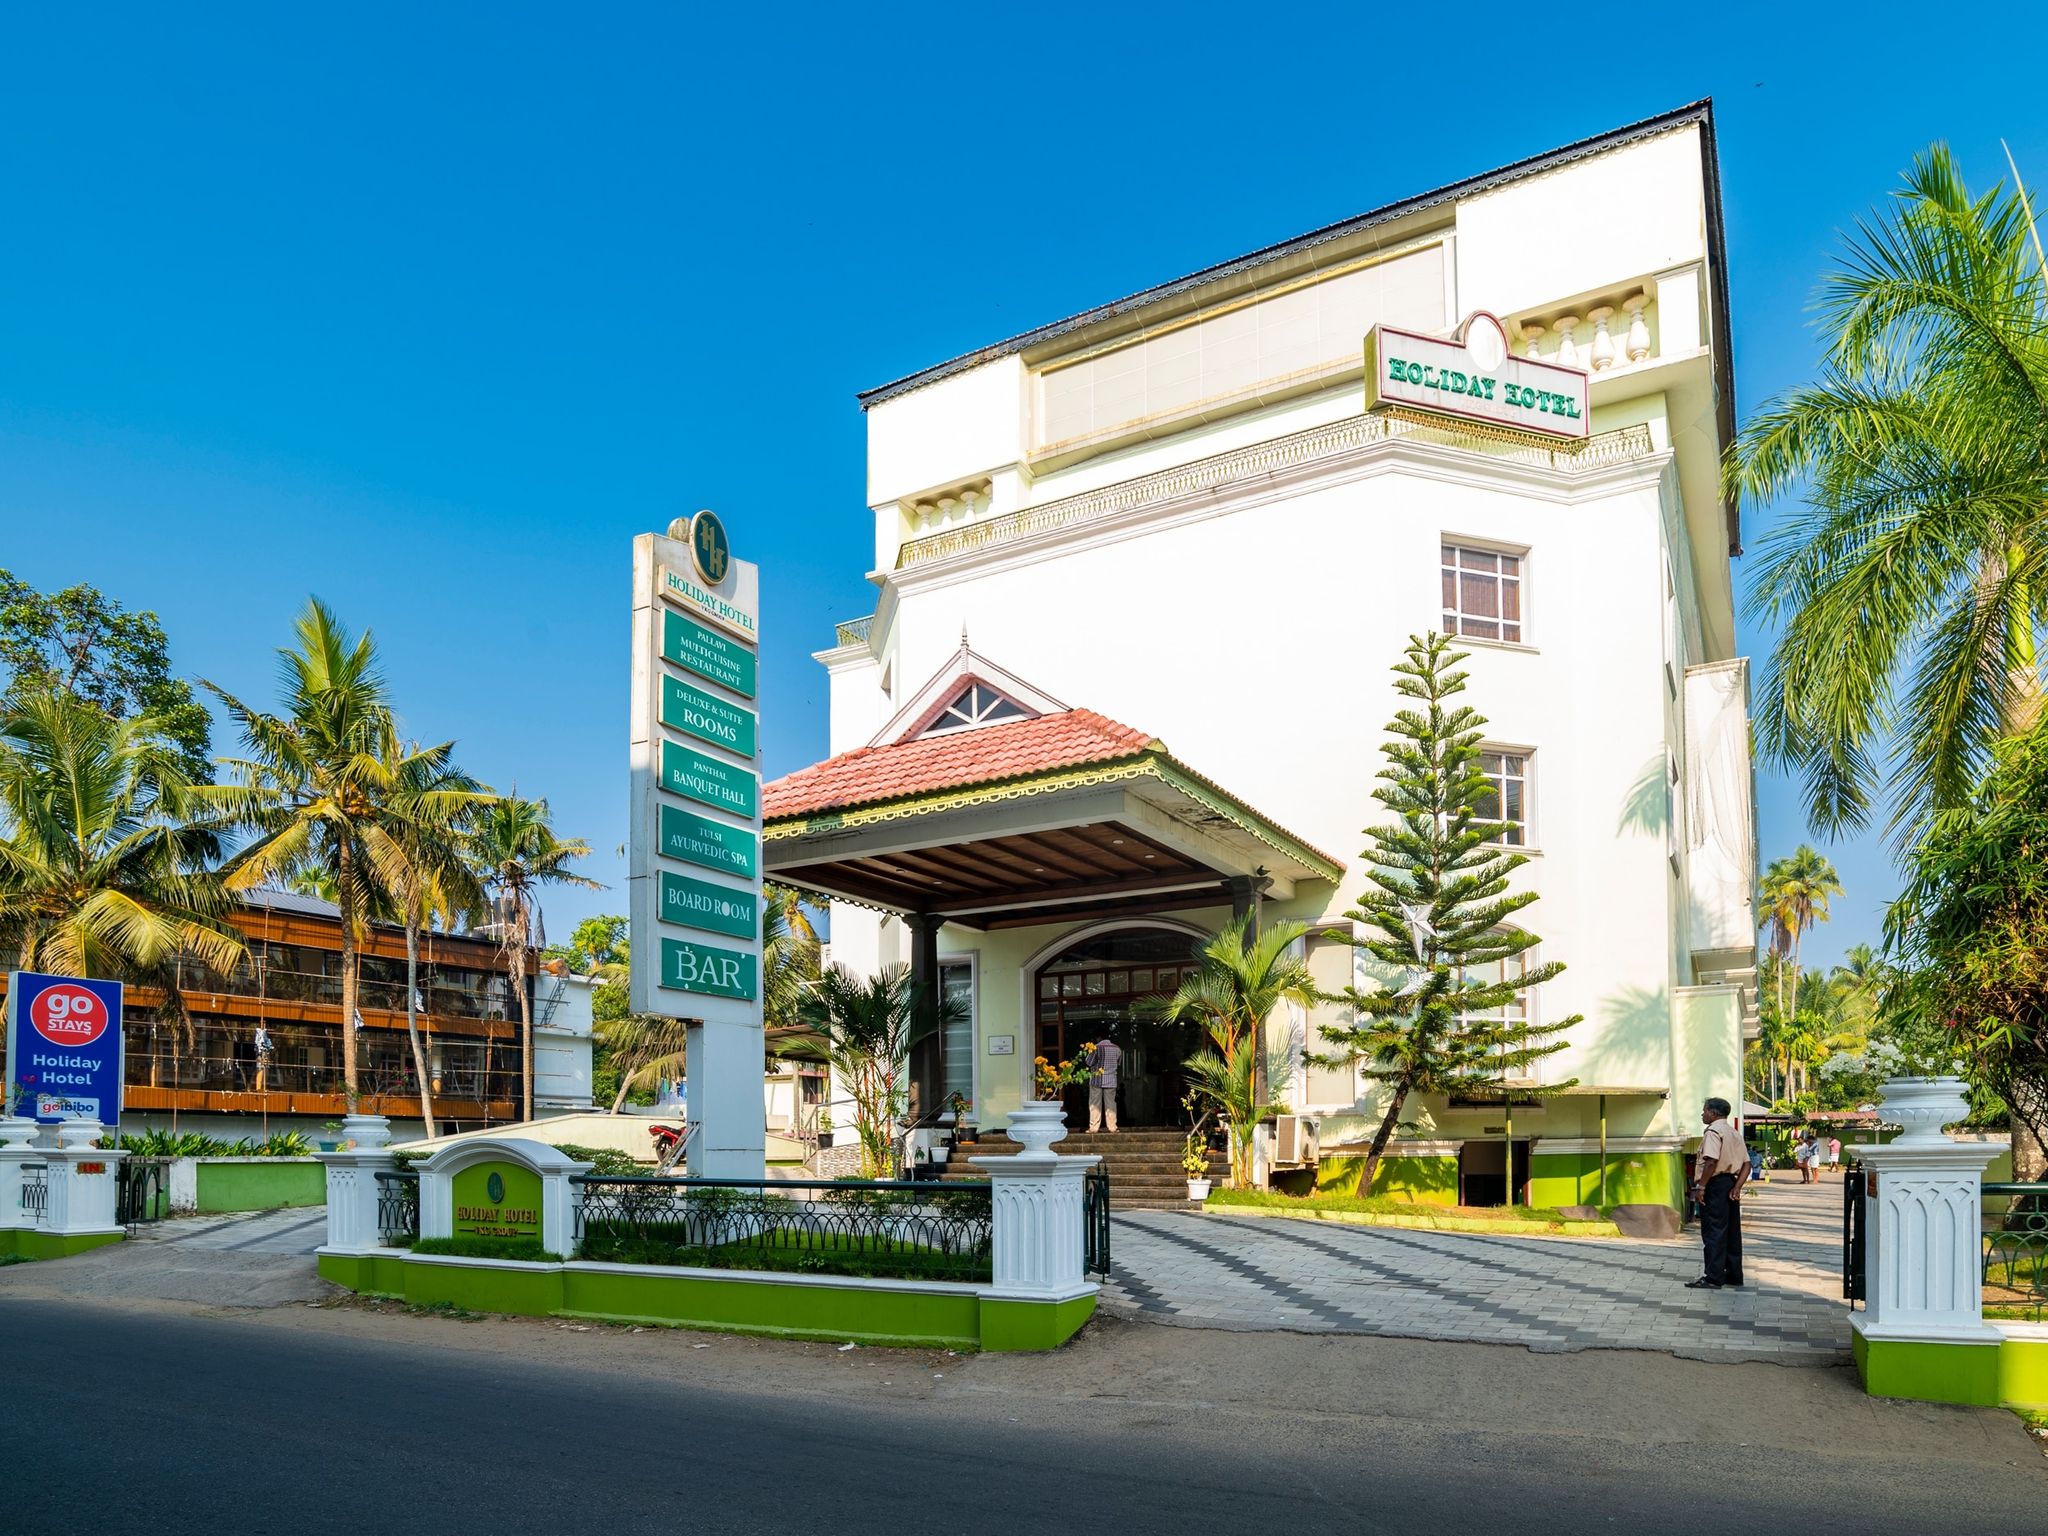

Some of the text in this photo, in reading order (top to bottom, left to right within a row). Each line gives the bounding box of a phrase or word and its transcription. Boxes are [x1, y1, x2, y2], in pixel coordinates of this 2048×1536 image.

[1388, 357, 1496, 400] HOLIDAY
[1504, 383, 1581, 419] HOTEL
[667, 572, 755, 631] HOLIDAY HOTEL
[680, 636, 741, 673] MULTICUISINE
[697, 631, 727, 651] PALLAVI
[680, 650, 741, 686] RESTAURANT
[676, 689, 743, 725] DELUXE & SUITE
[683, 708, 737, 742] ROOMS
[673, 769, 746, 806] BANQUET HALL
[693, 761, 727, 781] PANTHAL
[670, 834, 748, 867] AYURVEDIC SPA
[698, 827, 722, 842] TULSI
[668, 888, 750, 922] BOARD ROOM
[675, 950, 742, 989] BAR
[47, 993, 93, 1019] go
[48, 1019, 92, 1031] STAYS
[32, 1054, 102, 1072] Holiday
[42, 1072, 92, 1085] Hotel
[42, 1101, 94, 1114] goibibo
[458, 1207, 537, 1224] HOLIDAY HOTEL
